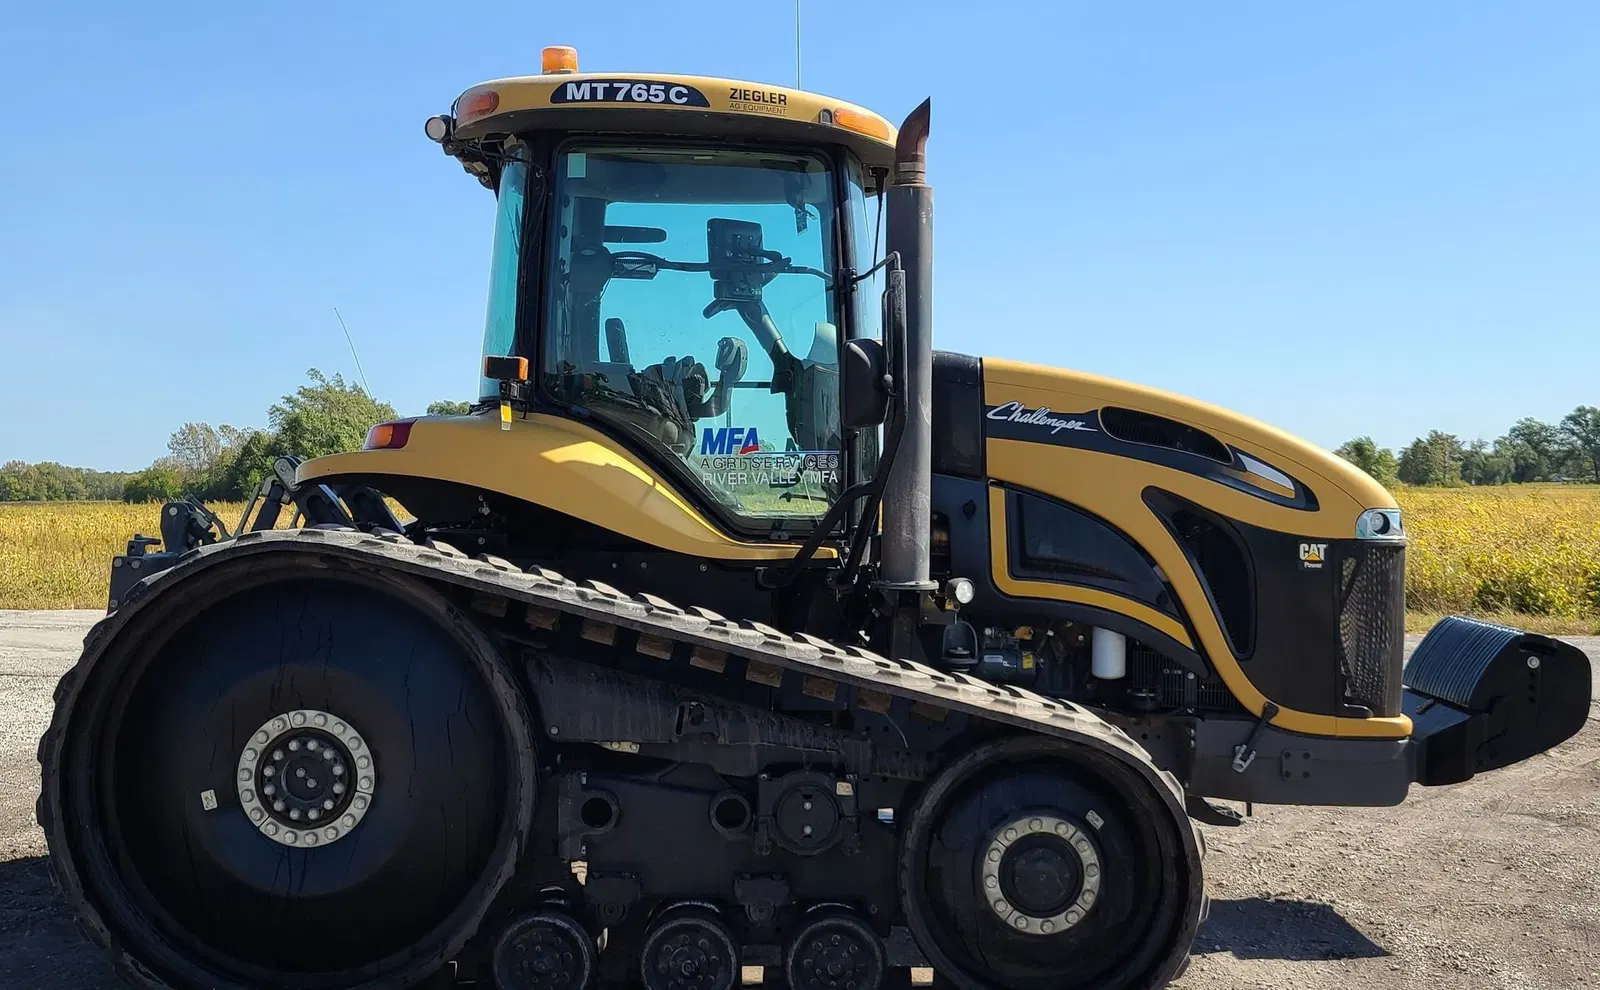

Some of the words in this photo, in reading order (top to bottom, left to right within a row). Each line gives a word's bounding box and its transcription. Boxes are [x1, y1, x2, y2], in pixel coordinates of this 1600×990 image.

[729, 87, 787, 106] ZIEGLER
[729, 102, 741, 110] AG
[743, 103, 787, 115] EQUIPMENT
[986, 401, 1098, 435] Challenger
[700, 427, 760, 456] MFA
[751, 455, 839, 470] SERVICES
[702, 471, 748, 485] RIVER
[751, 471, 806, 485] VALLEY
[810, 470, 839, 484] MFA
[1299, 543, 1327, 561] CAT
